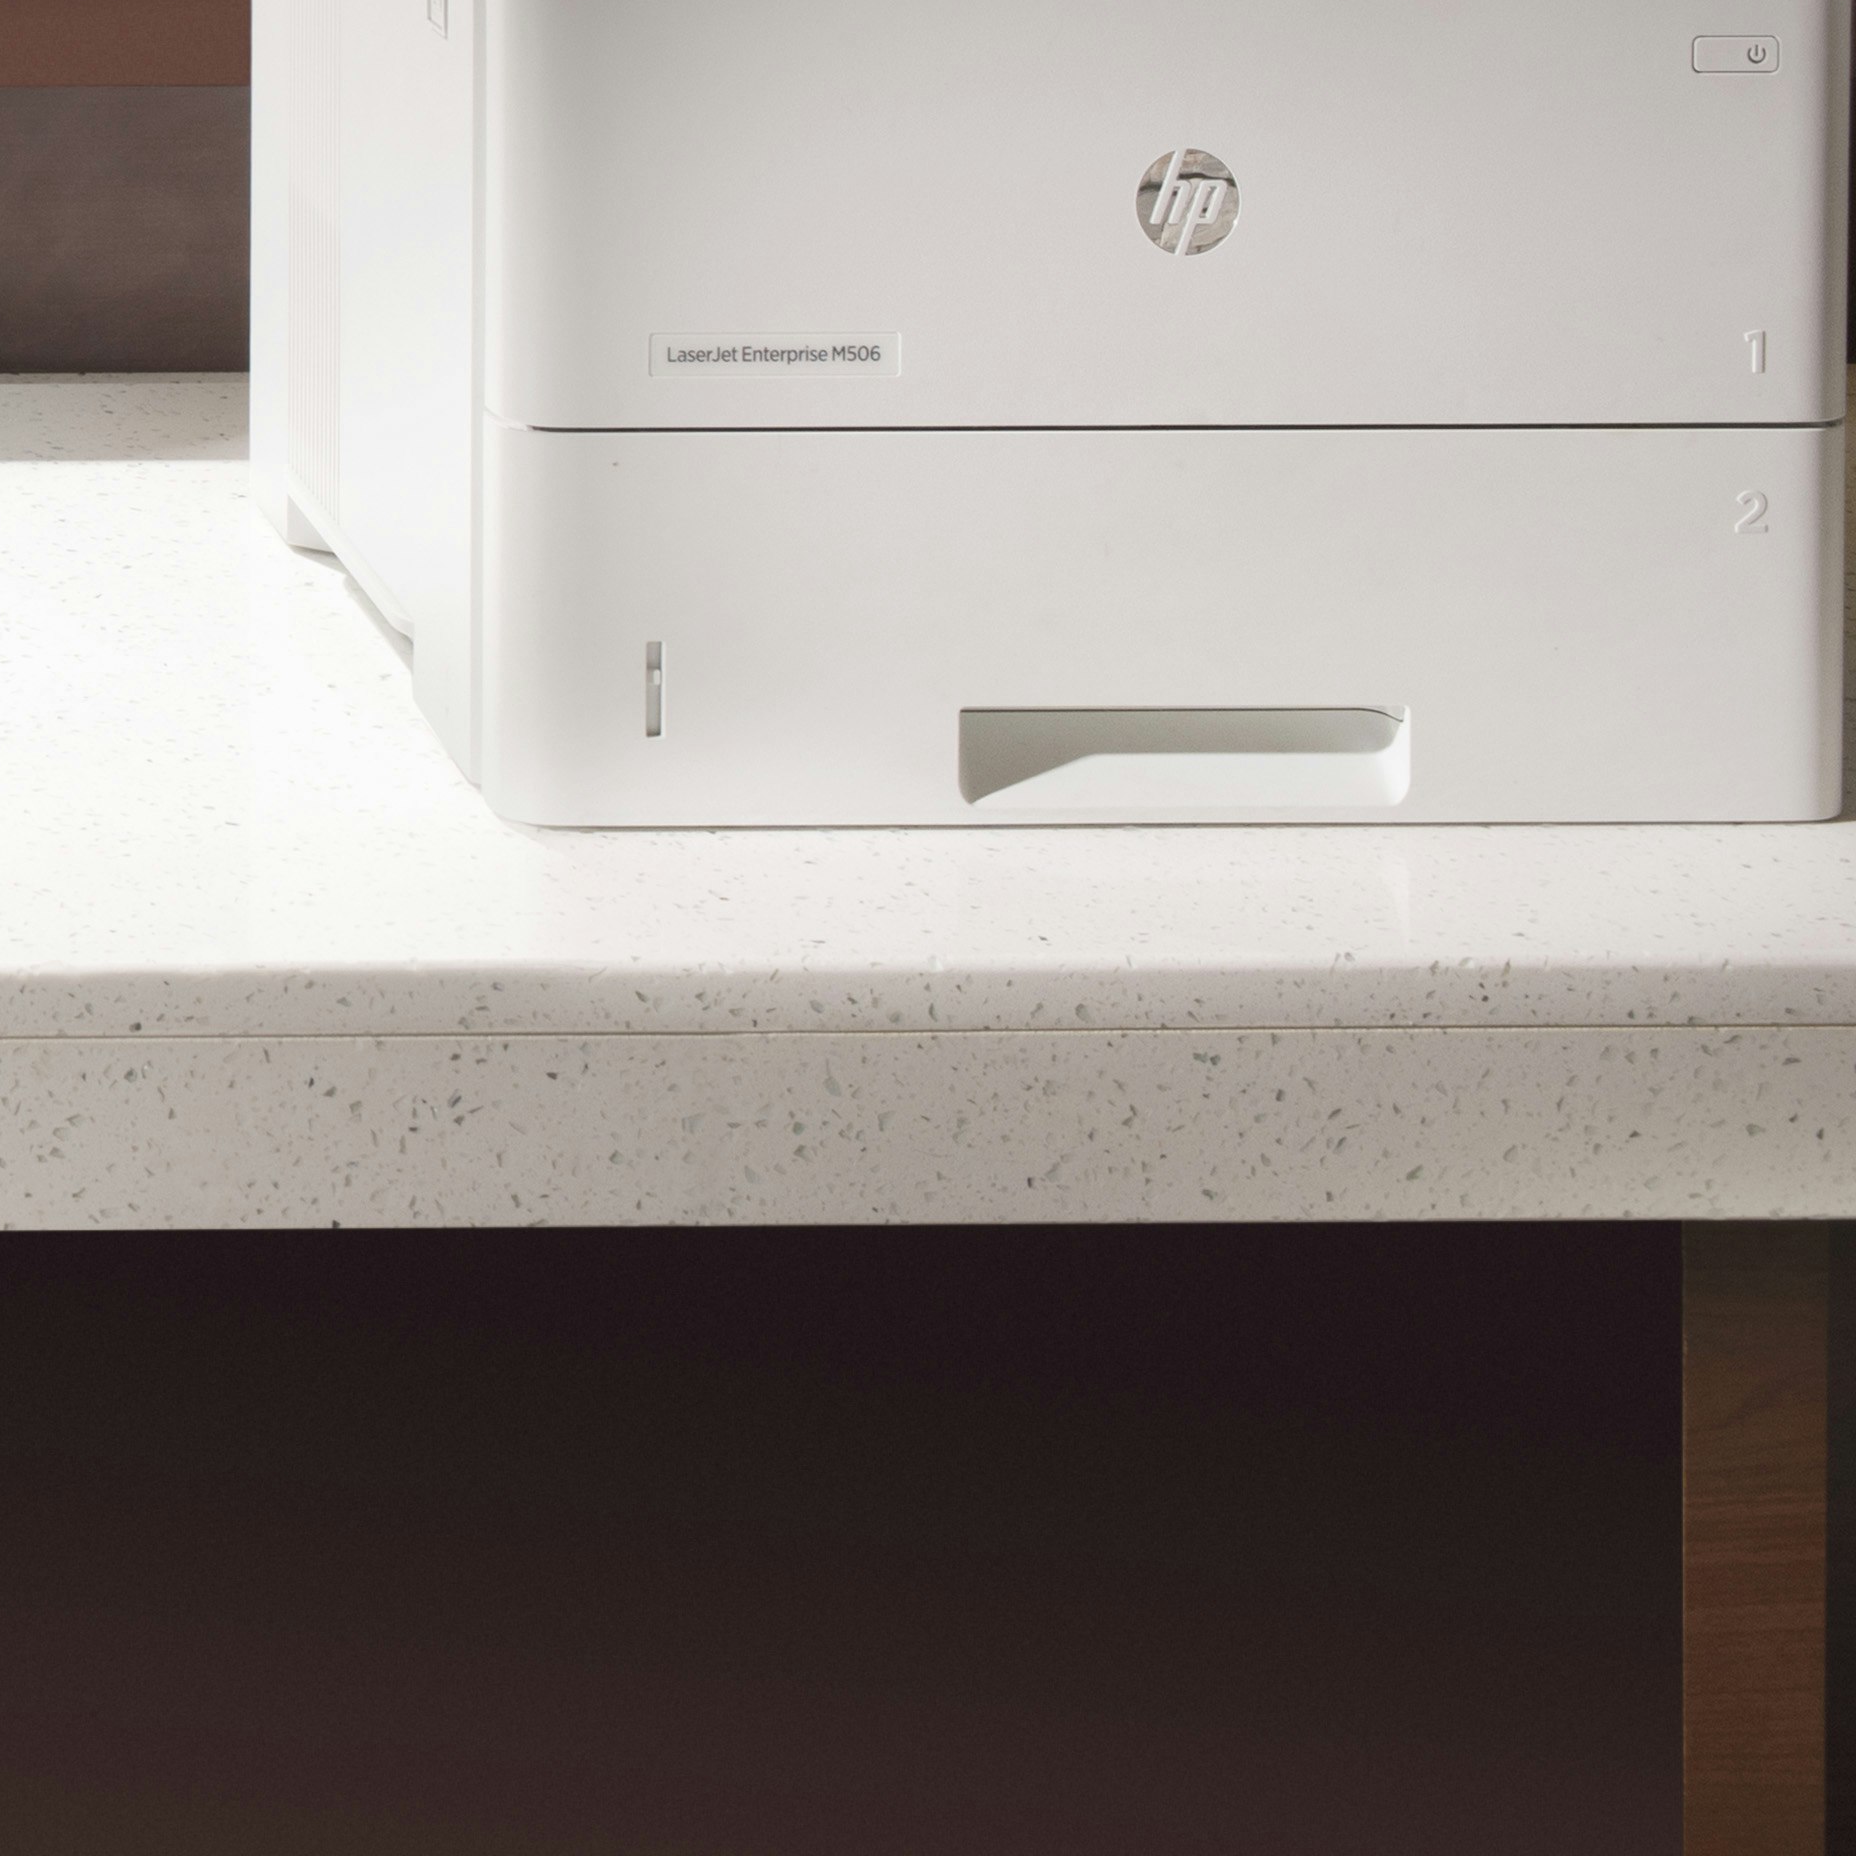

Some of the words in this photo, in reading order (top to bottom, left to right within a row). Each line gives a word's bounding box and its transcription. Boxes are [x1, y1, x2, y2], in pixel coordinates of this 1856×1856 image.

[667, 346, 737, 362] LaserJet
[742, 345, 828, 364] Enterprise
[832, 345, 881, 362] M506
[1734, 489, 1769, 534] 2
